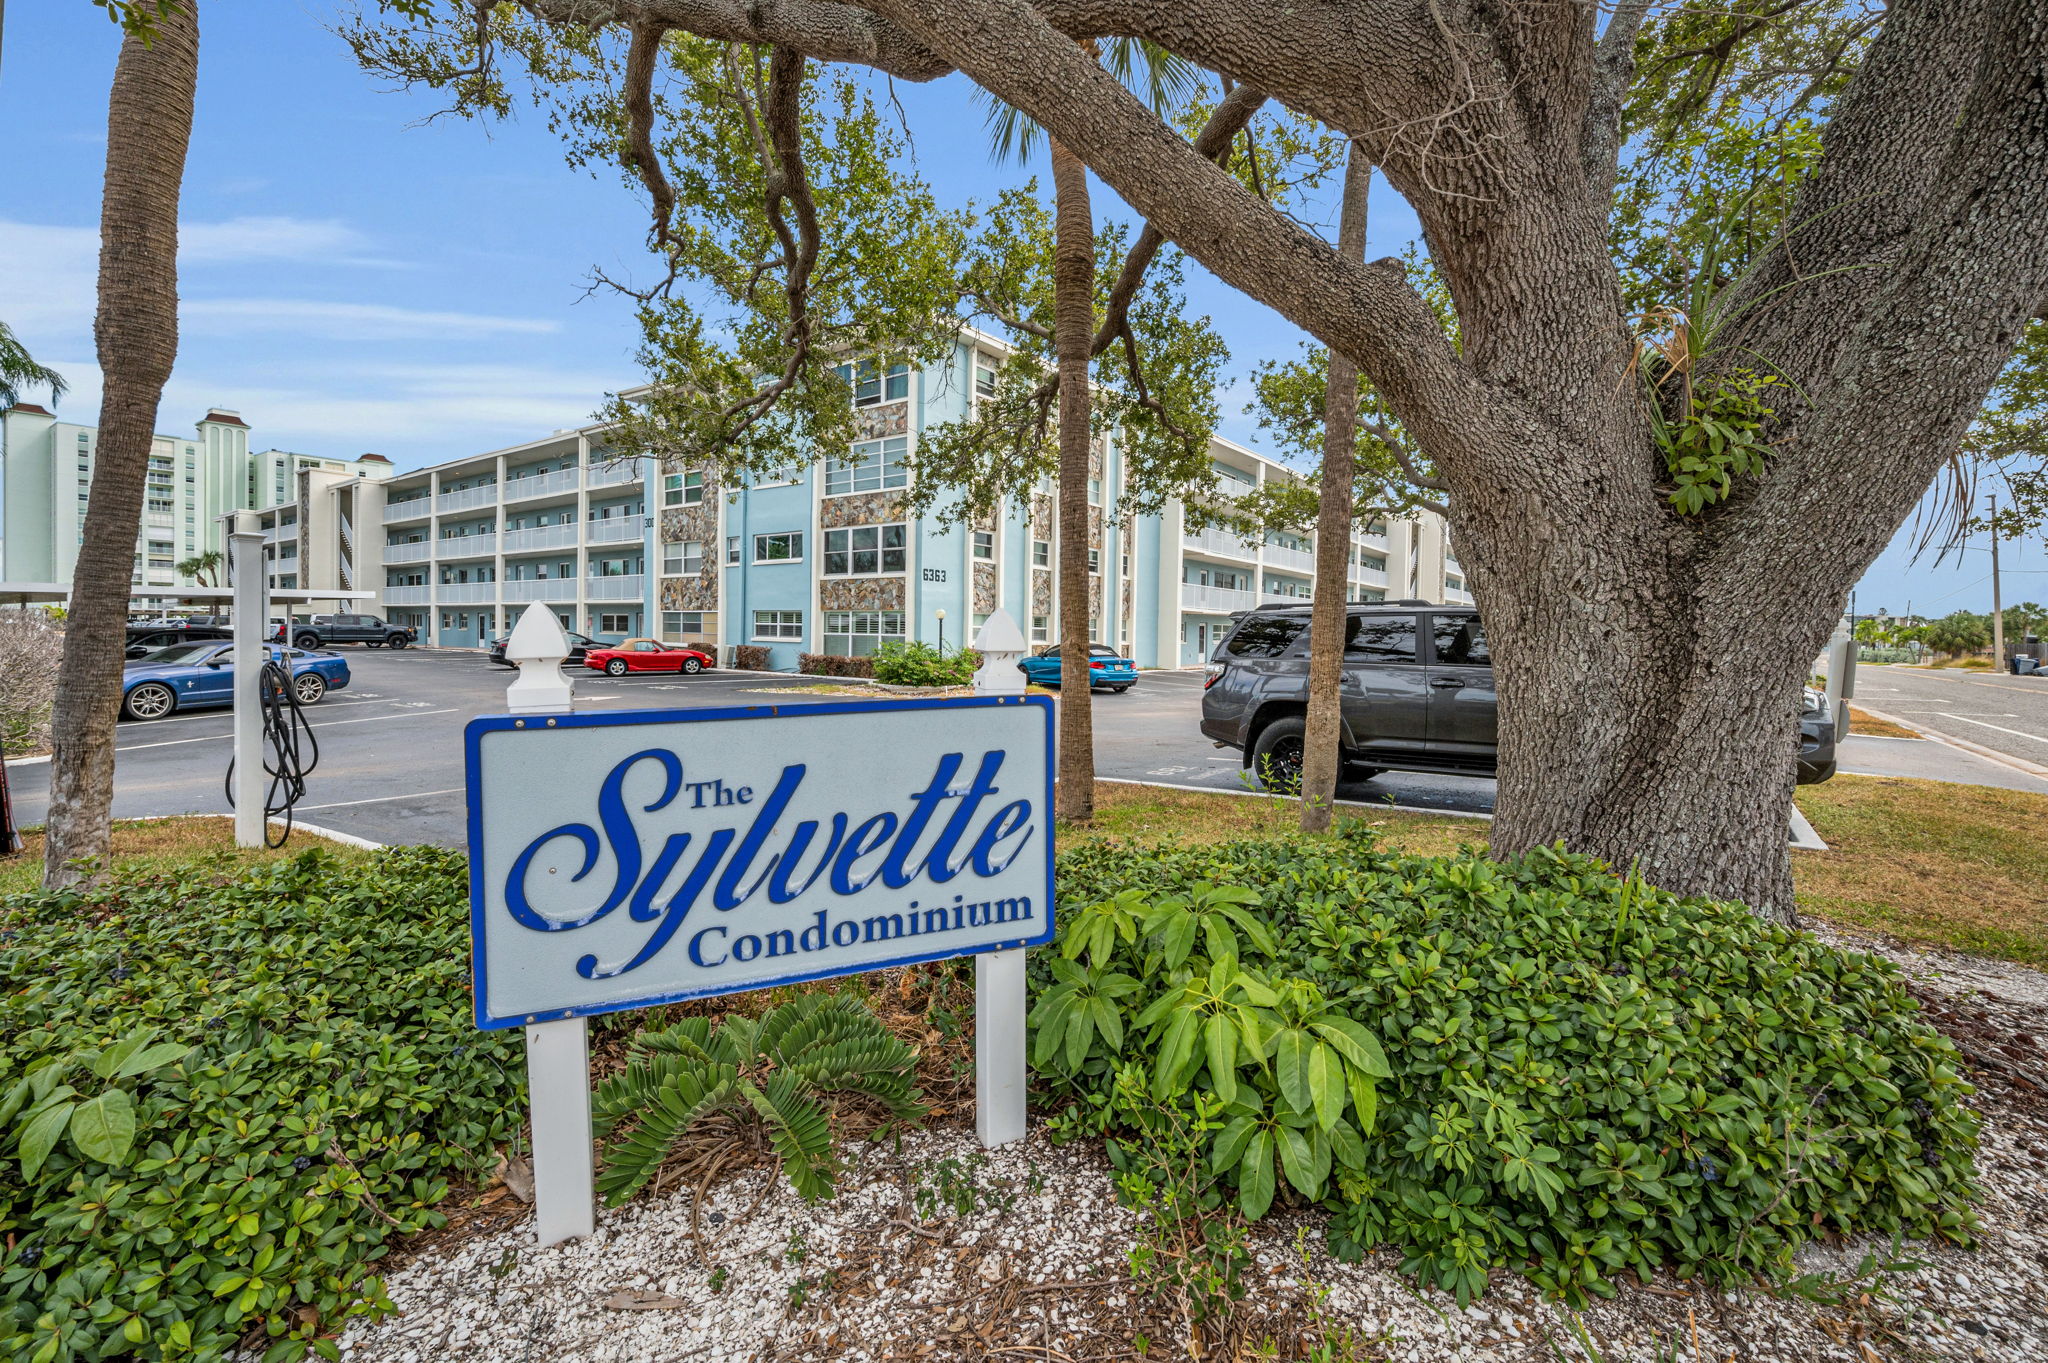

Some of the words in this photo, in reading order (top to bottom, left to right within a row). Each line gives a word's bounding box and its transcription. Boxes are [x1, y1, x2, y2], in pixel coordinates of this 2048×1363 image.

[923, 568, 946, 582] 6363
[685, 778, 754, 810] The
[504, 747, 1034, 980] Sylvette
[688, 894, 1034, 968] Condominium
